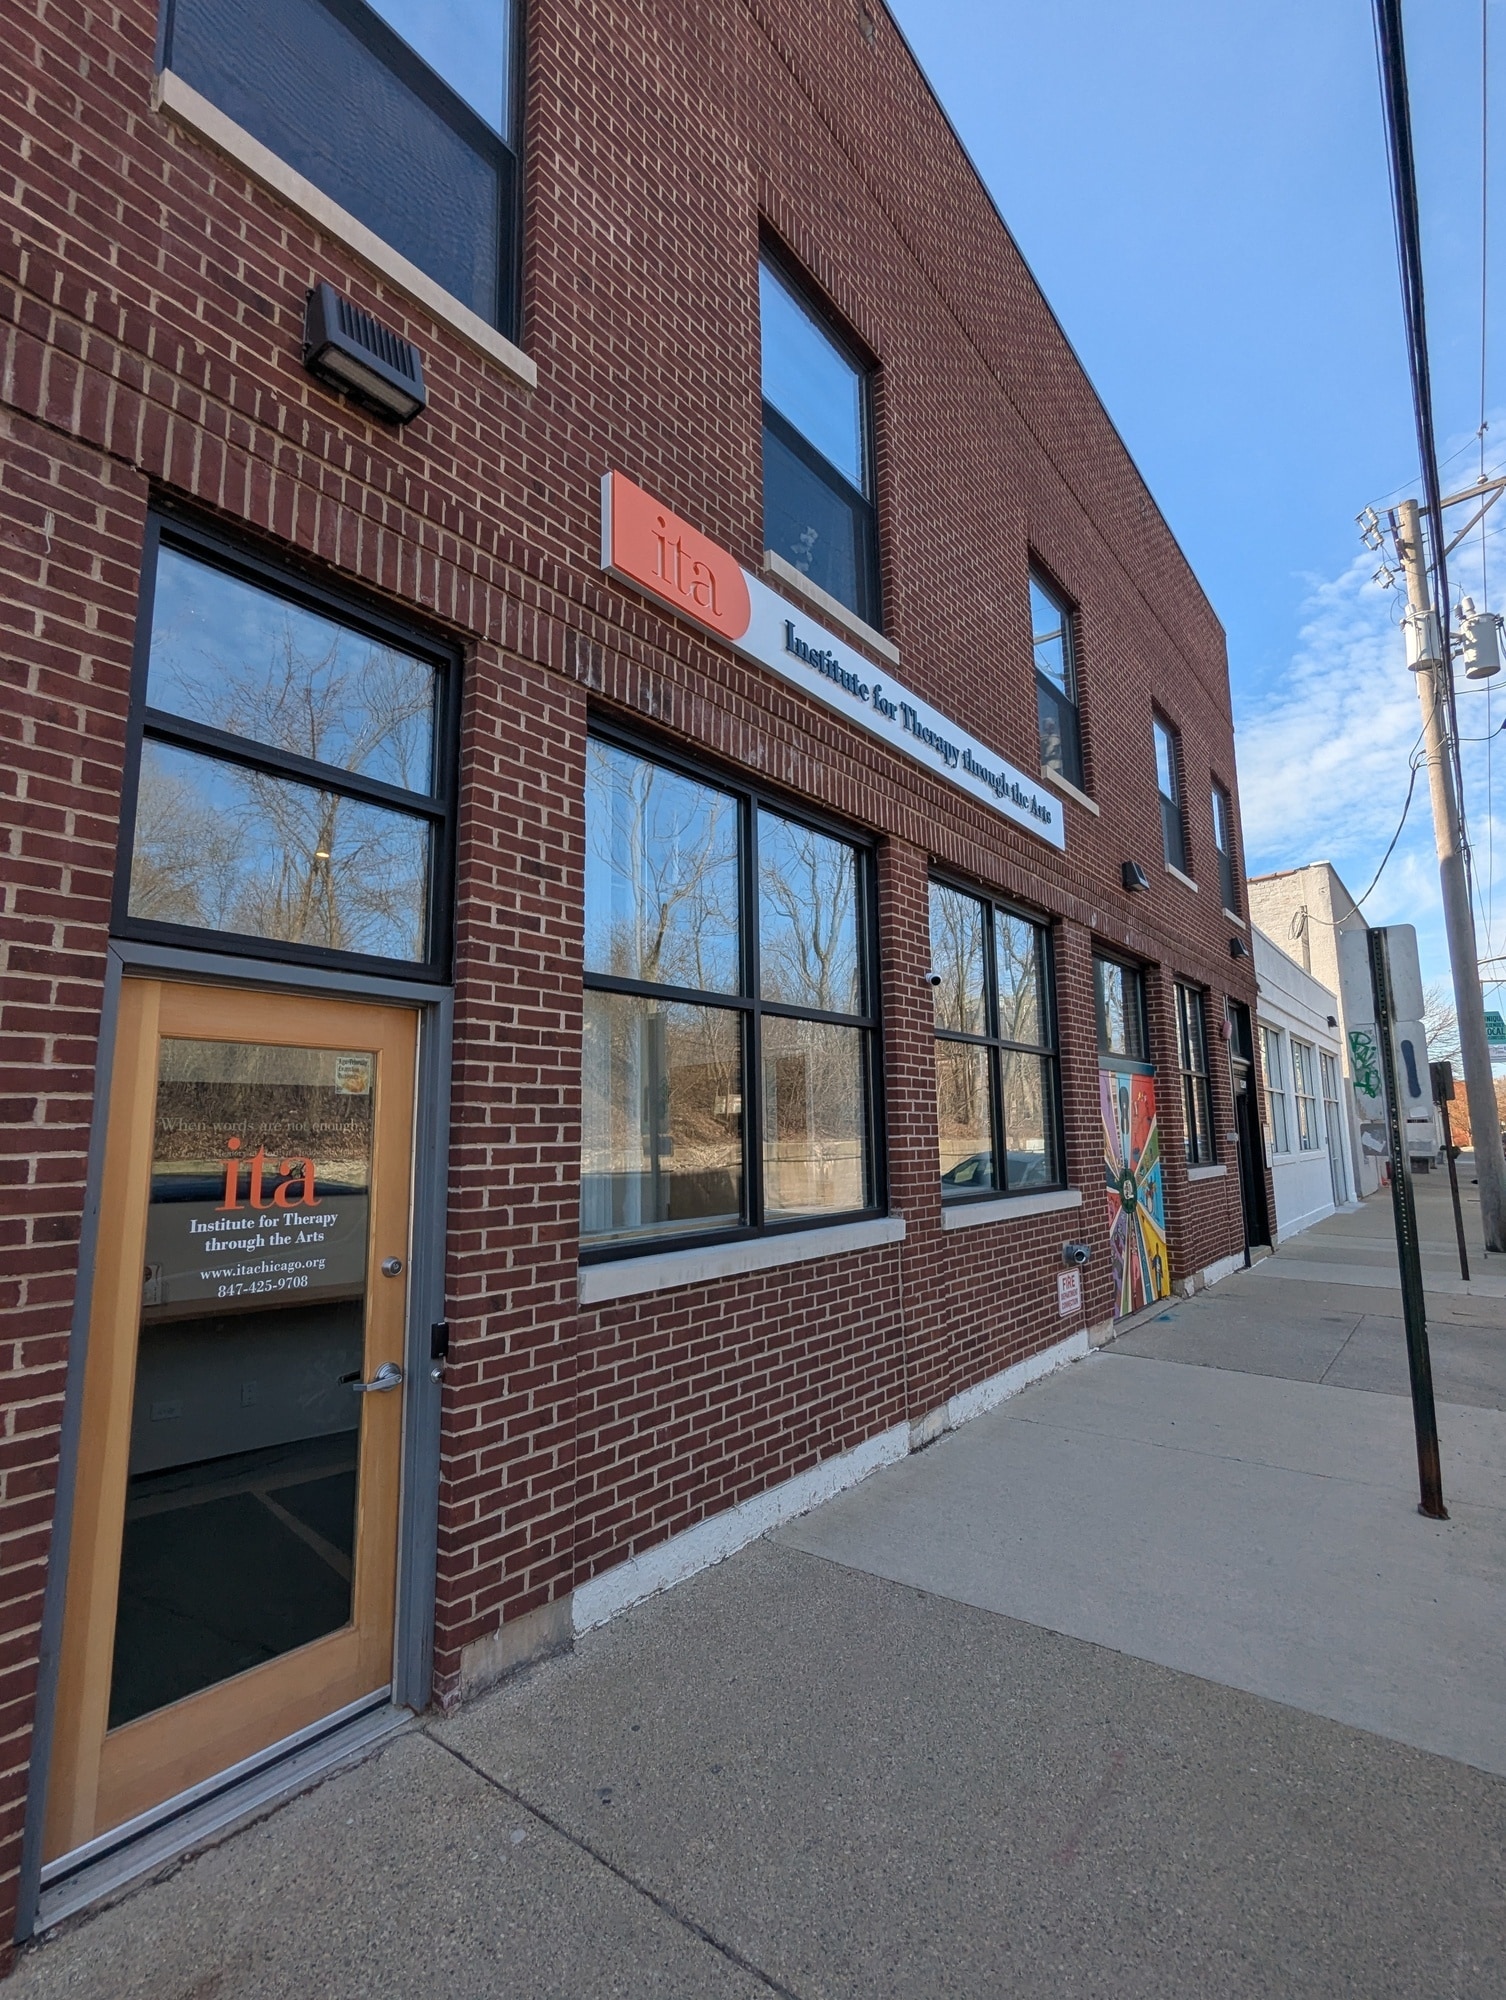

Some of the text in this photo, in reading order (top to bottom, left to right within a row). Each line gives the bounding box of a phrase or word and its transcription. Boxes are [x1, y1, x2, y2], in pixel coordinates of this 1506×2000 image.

[651, 515, 723, 617] ita
[784, 618, 1052, 824] Institute for Therapy through the Arts
[160, 1117, 206, 1132] When
[212, 1119, 255, 1132] words
[260, 1120, 282, 1131] are
[287, 1119, 307, 1131] not
[215, 1137, 322, 1211] ita
[189, 1212, 338, 1234] Institute for Therapy
[205, 1230, 325, 1252] through the Arts
[200, 1257, 326, 1280] www.itachicago.org
[217, 1275, 308, 1298] 847-425-9708
[1062, 1275, 1076, 1291] FIRE
